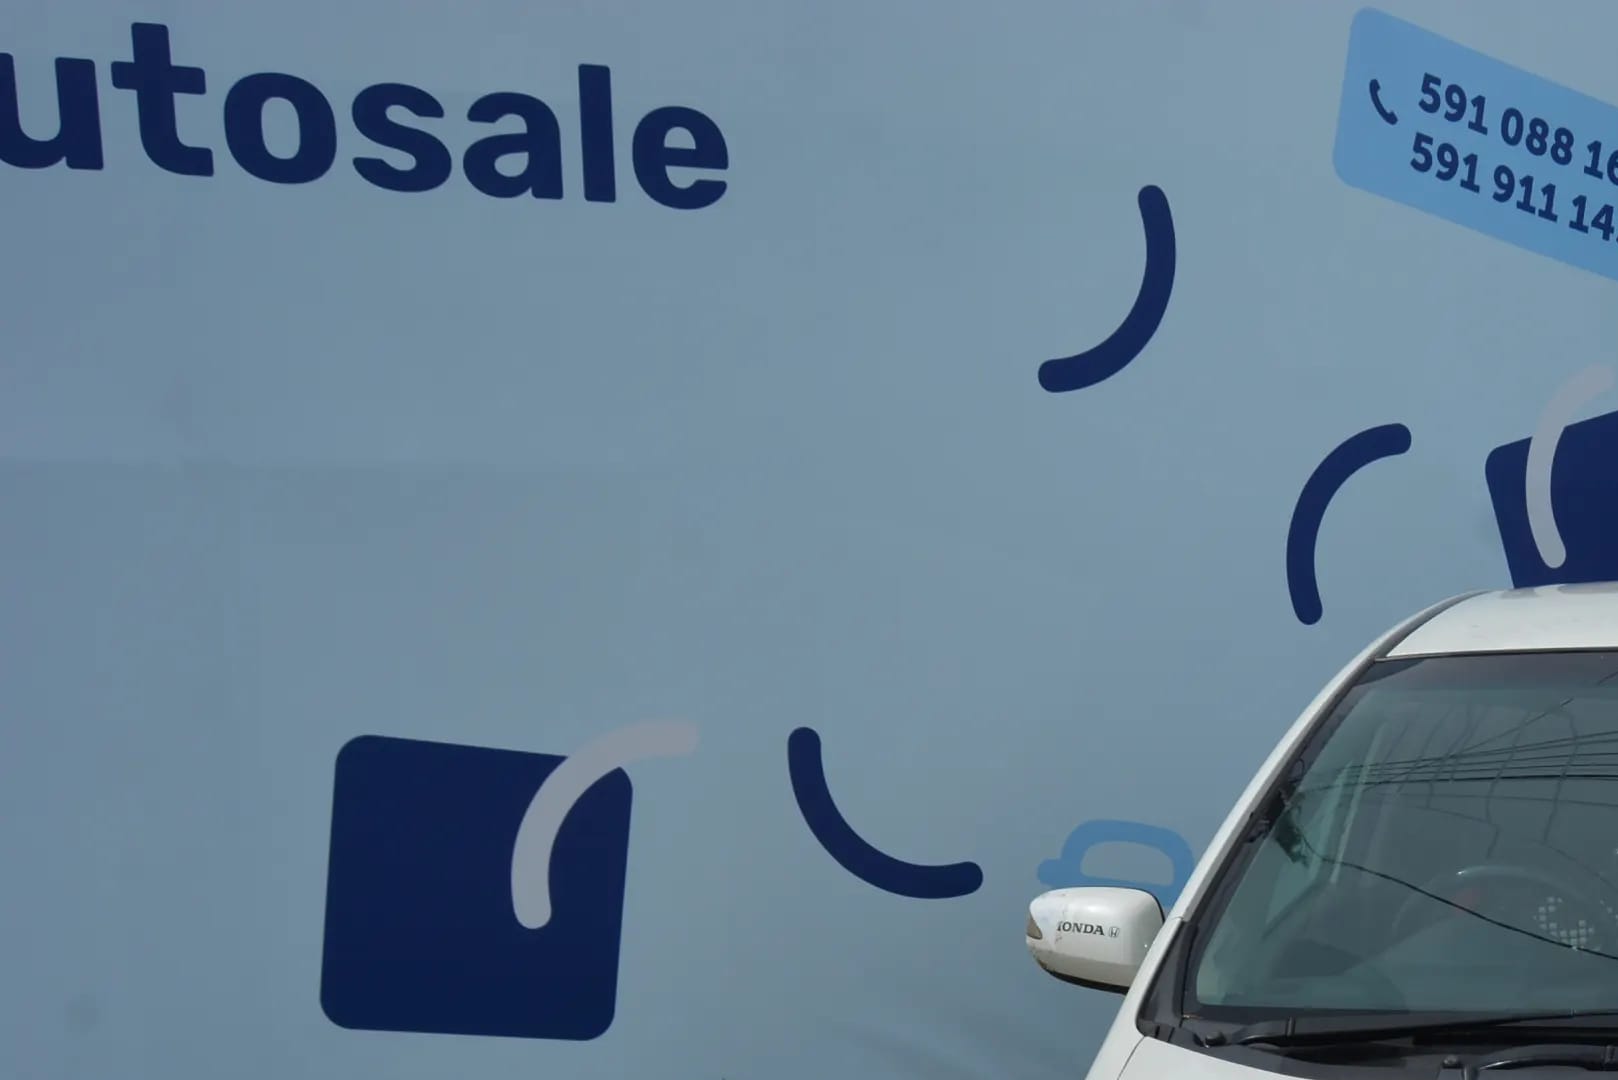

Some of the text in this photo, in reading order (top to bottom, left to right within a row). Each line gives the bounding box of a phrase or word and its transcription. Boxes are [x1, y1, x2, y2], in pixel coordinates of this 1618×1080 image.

[0, 22, 729, 210] utosale
[1418, 72, 1488, 136] 591
[1500, 107, 1575, 166] 088
[1410, 131, 1481, 194] 591
[1492, 164, 1559, 223] 911
